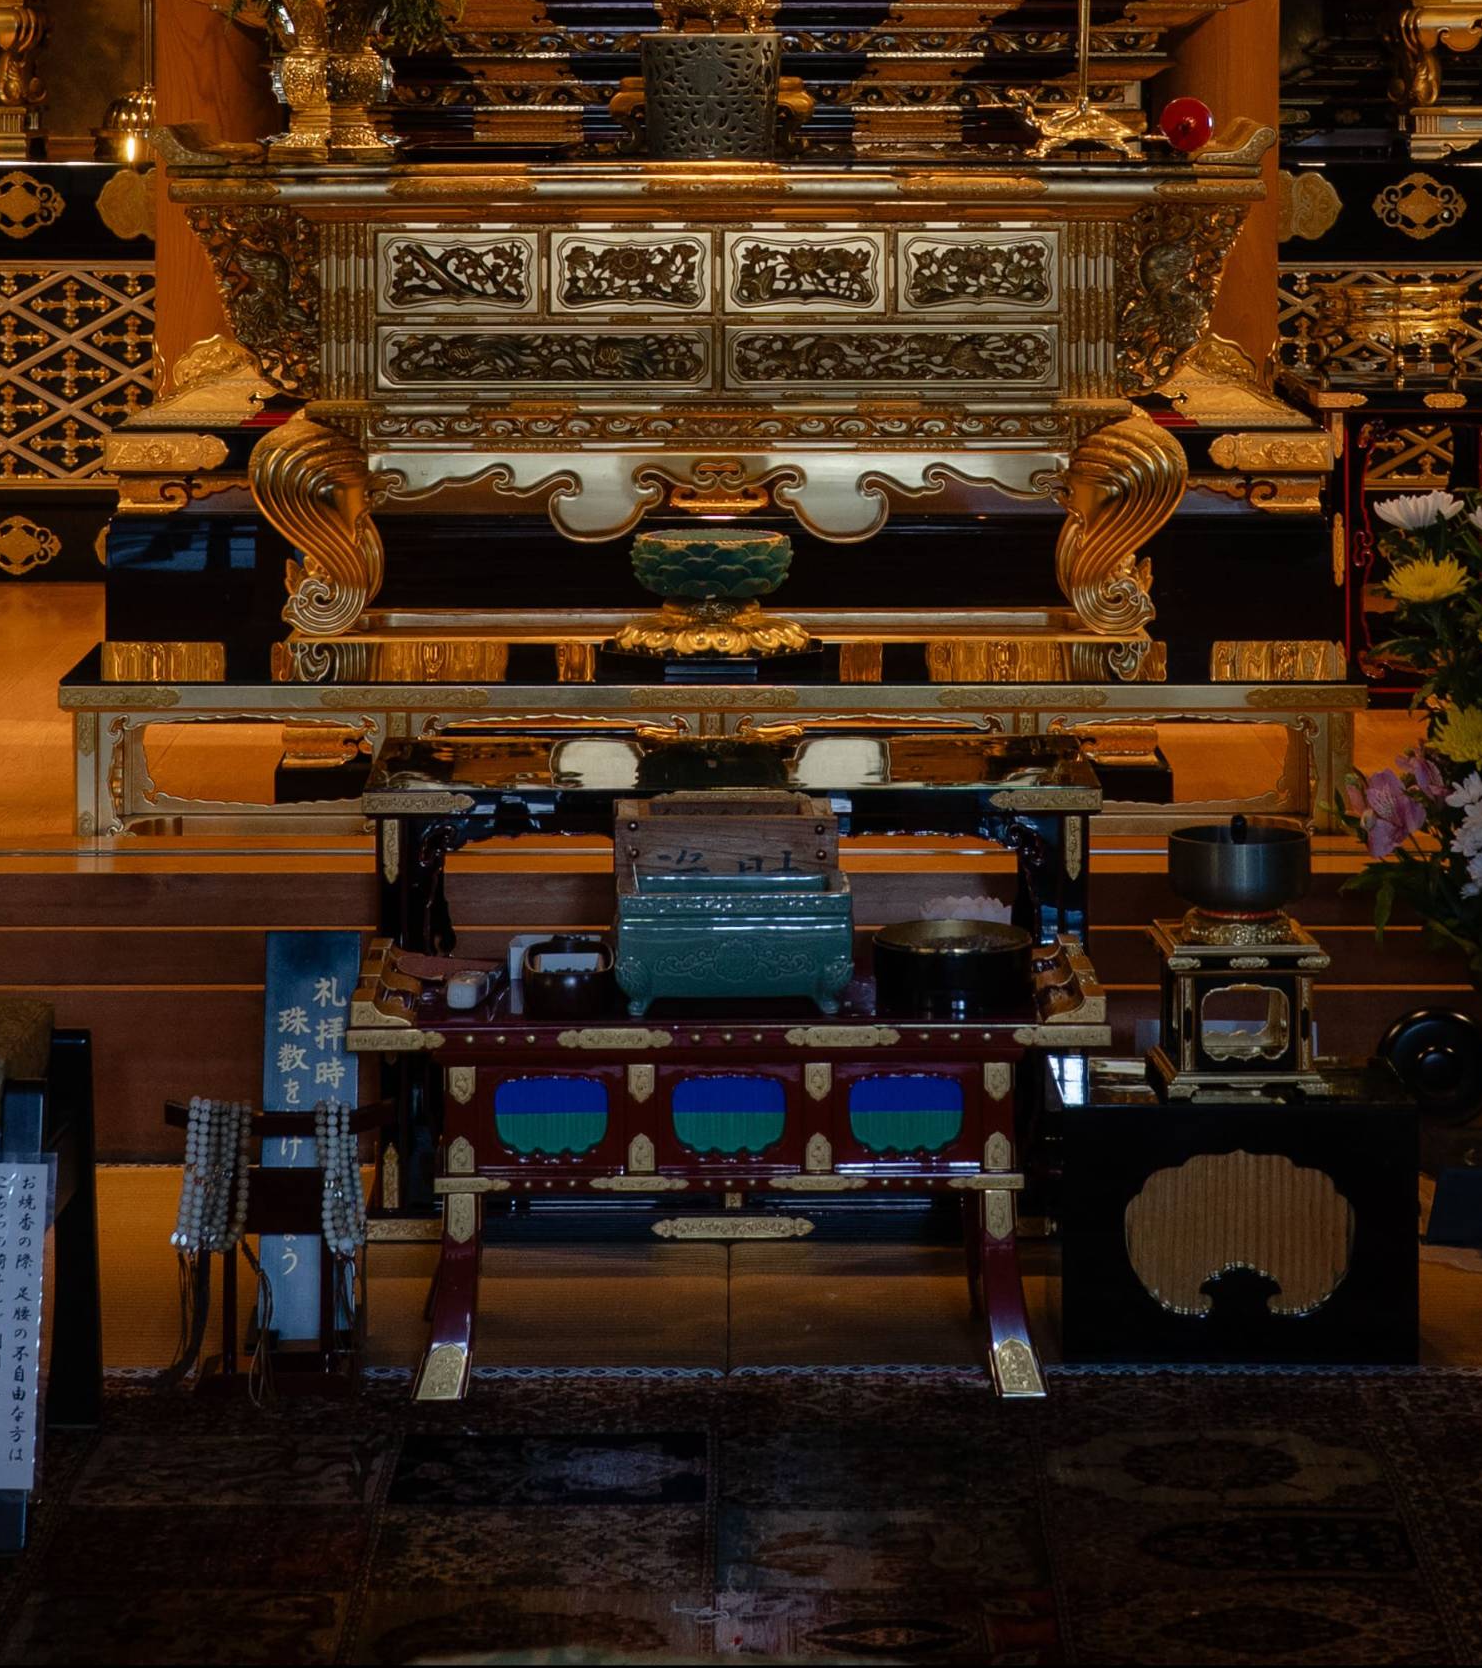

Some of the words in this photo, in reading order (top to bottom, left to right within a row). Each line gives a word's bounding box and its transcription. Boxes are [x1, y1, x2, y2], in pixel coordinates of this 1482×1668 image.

[9, 1175, 36, 1462] お焼香の際、足腰の不自由な方は
